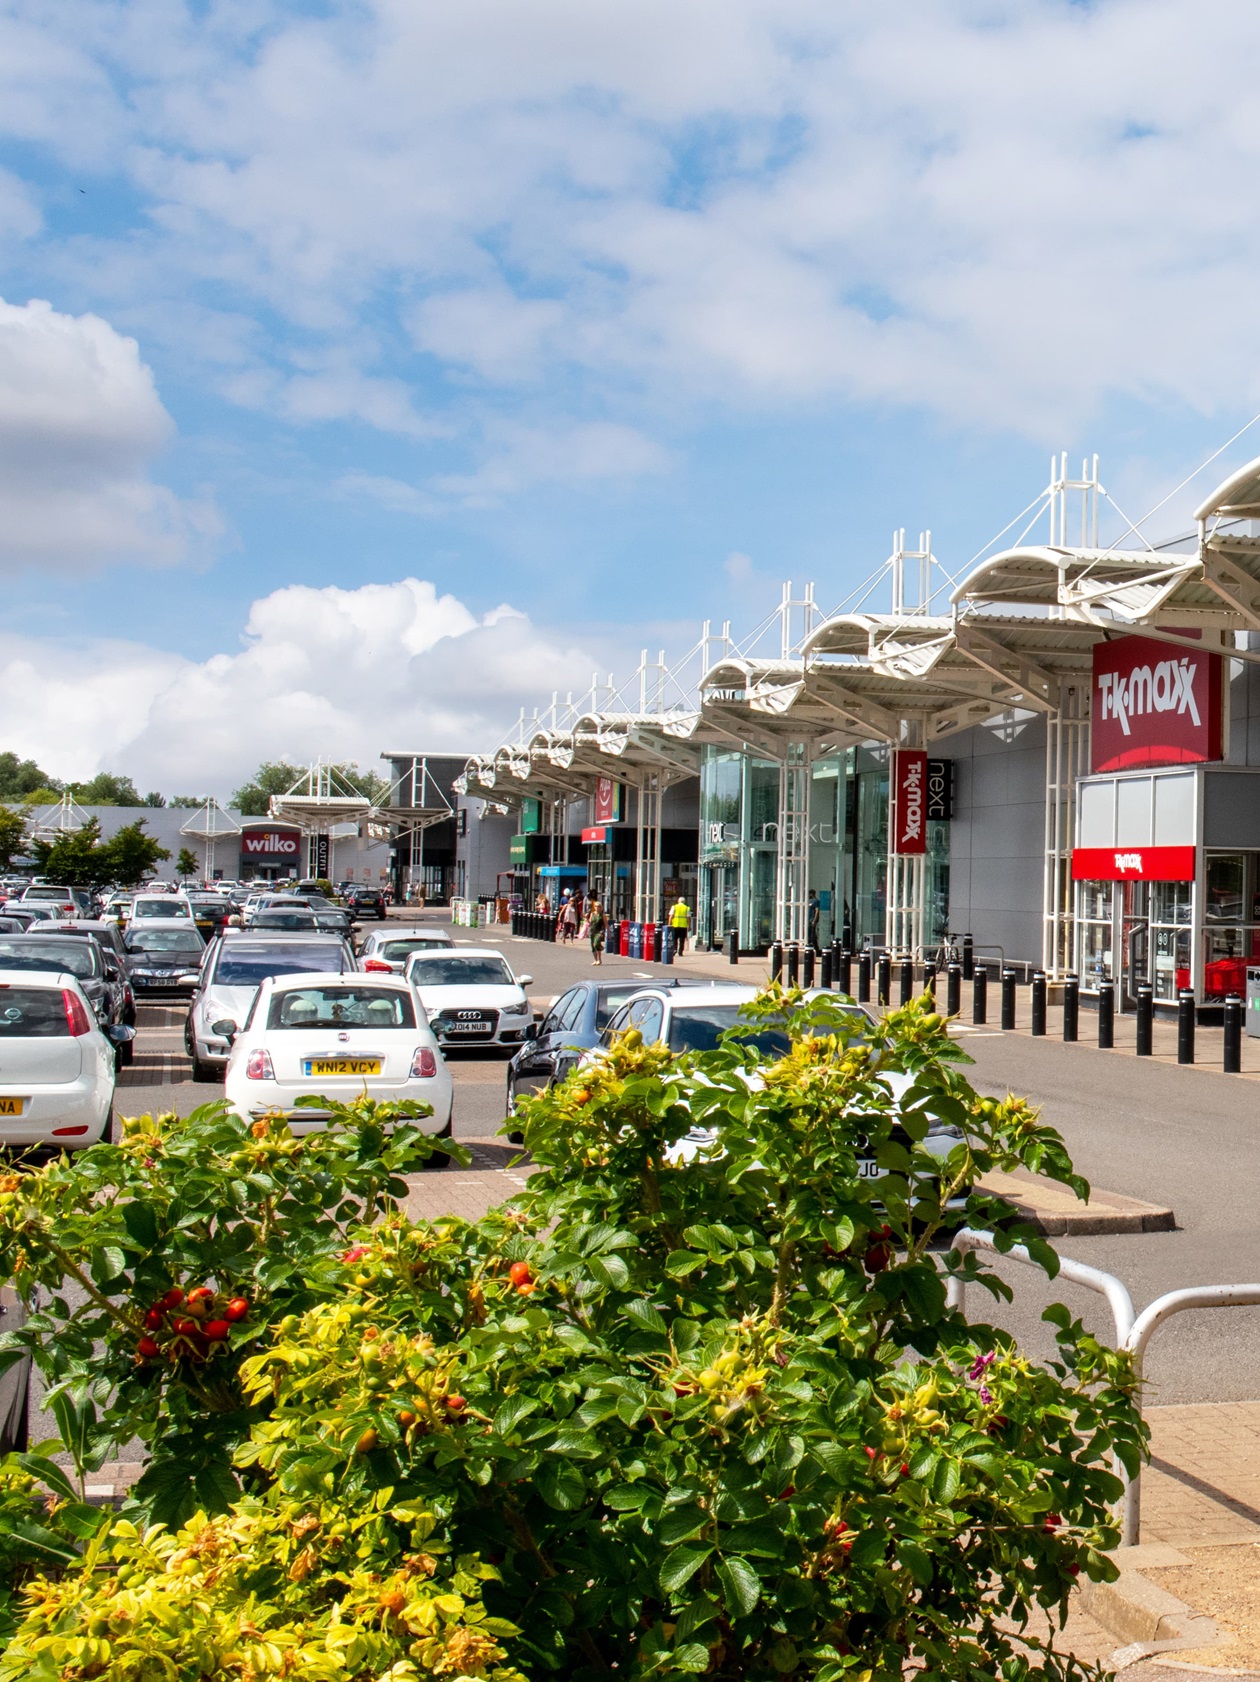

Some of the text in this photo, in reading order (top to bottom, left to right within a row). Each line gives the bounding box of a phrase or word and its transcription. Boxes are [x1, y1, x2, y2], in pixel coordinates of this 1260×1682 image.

[929, 762, 945, 817] next
[246, 834, 296, 852] wilko
[316, 1061, 375, 1072] WN12 VCY
